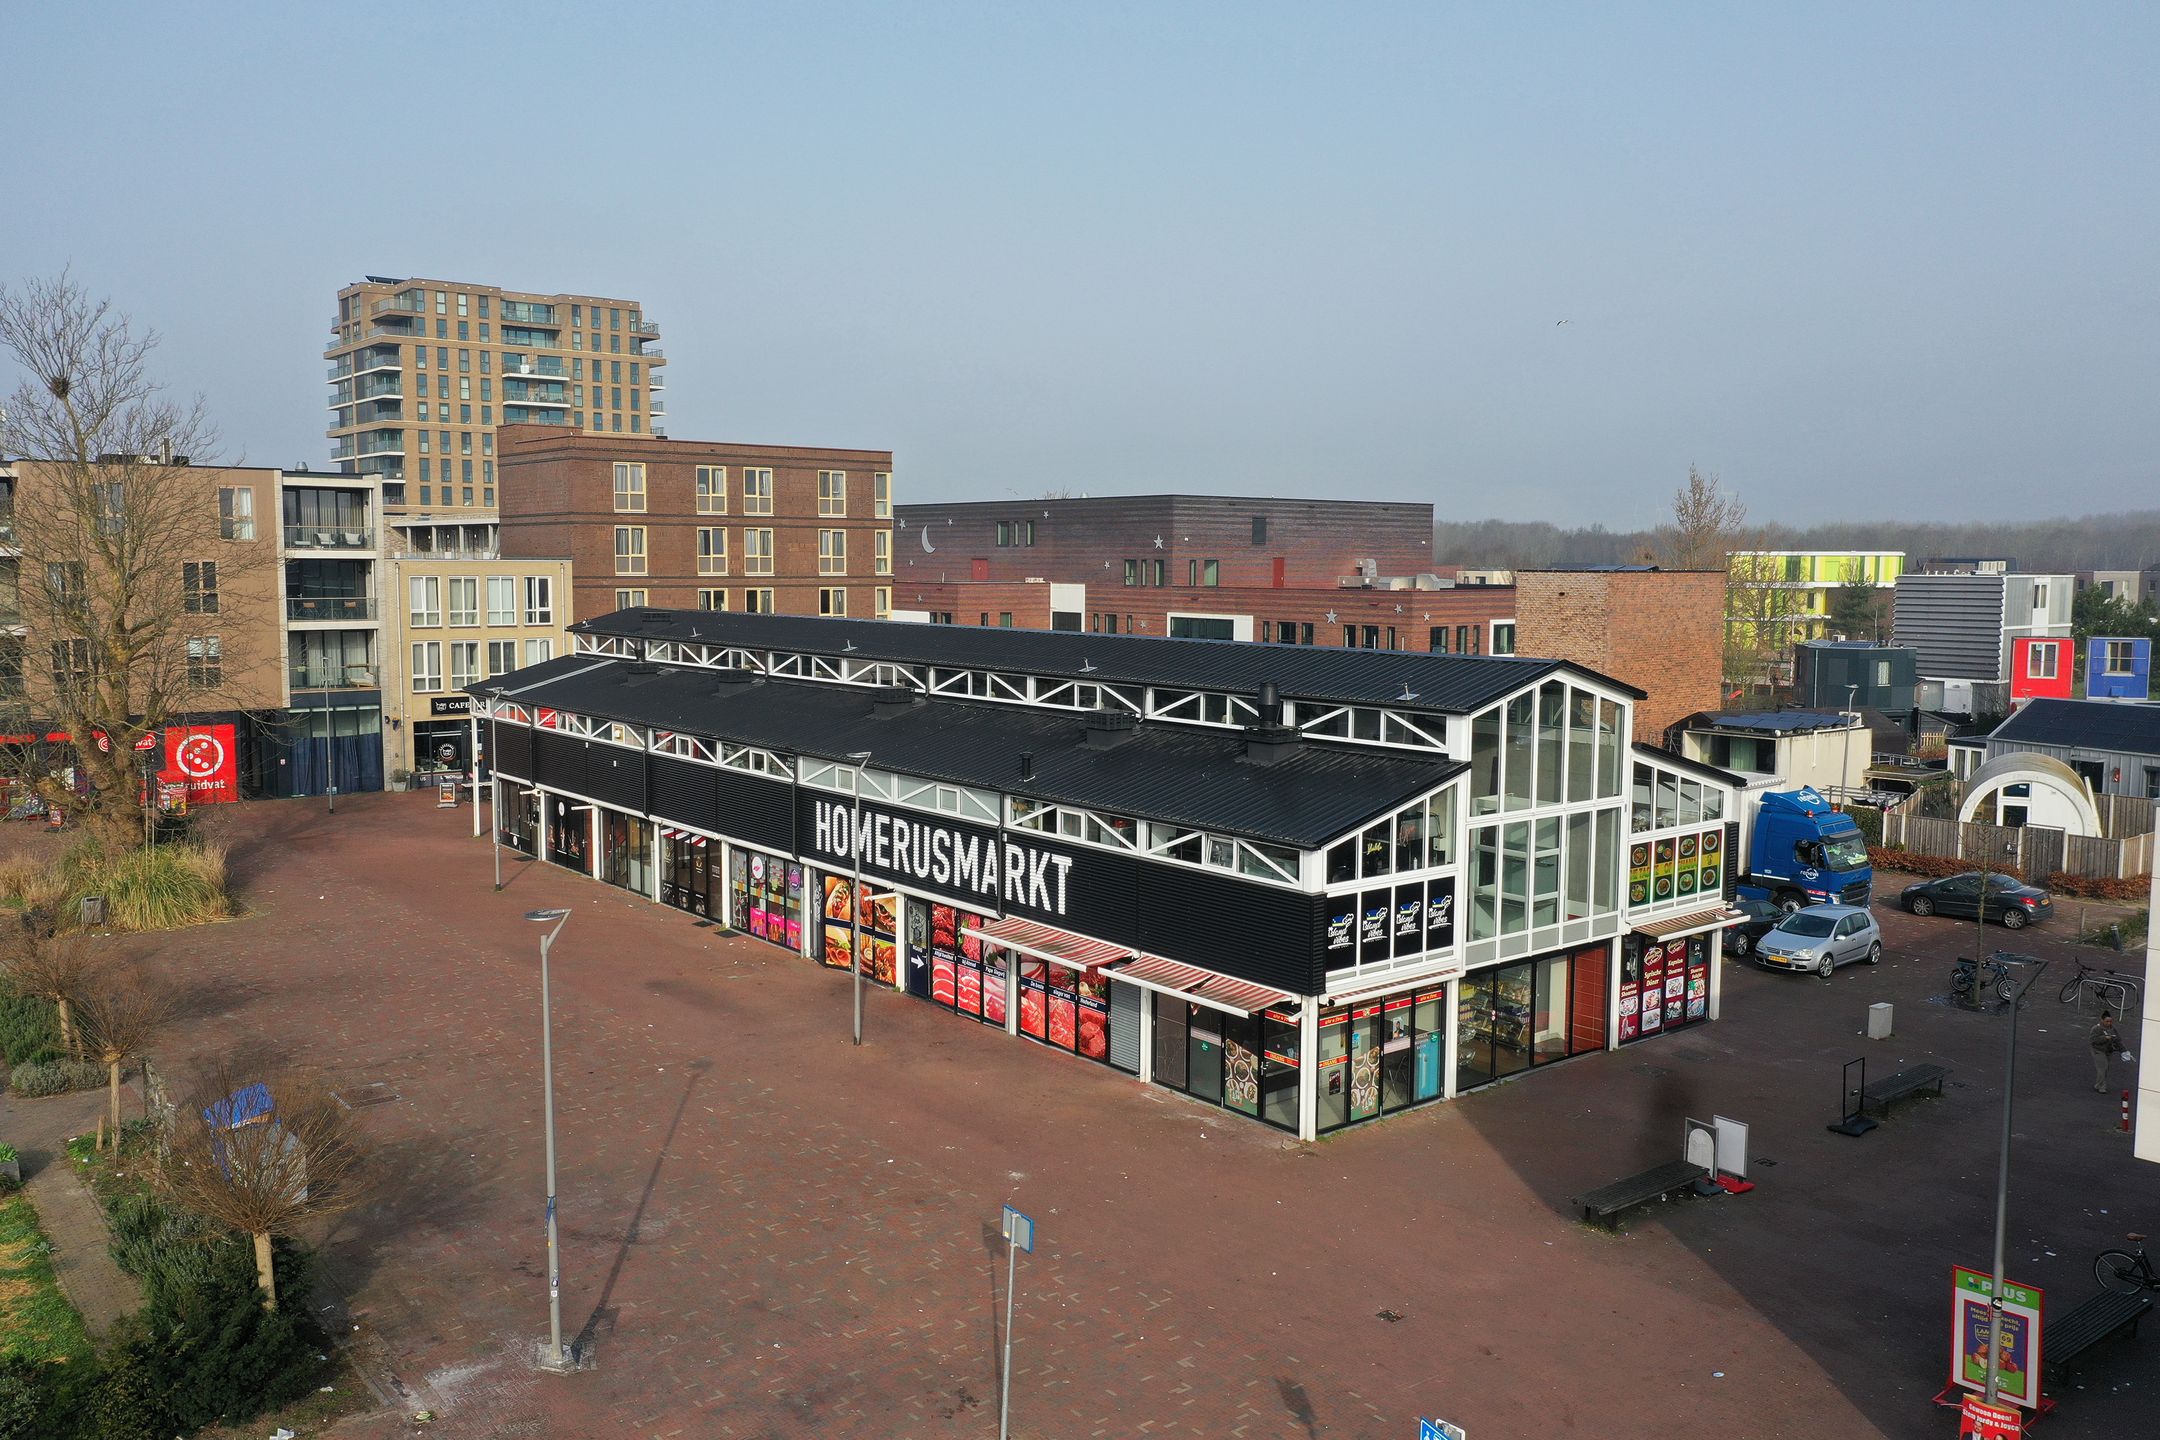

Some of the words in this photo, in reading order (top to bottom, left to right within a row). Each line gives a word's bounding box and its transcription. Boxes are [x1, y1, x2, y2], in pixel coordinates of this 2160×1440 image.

[180, 779, 225, 790] ruidvat
[815, 800, 1073, 916] HOMERUSMARKT
[1981, 1280, 2027, 1303] PUS
